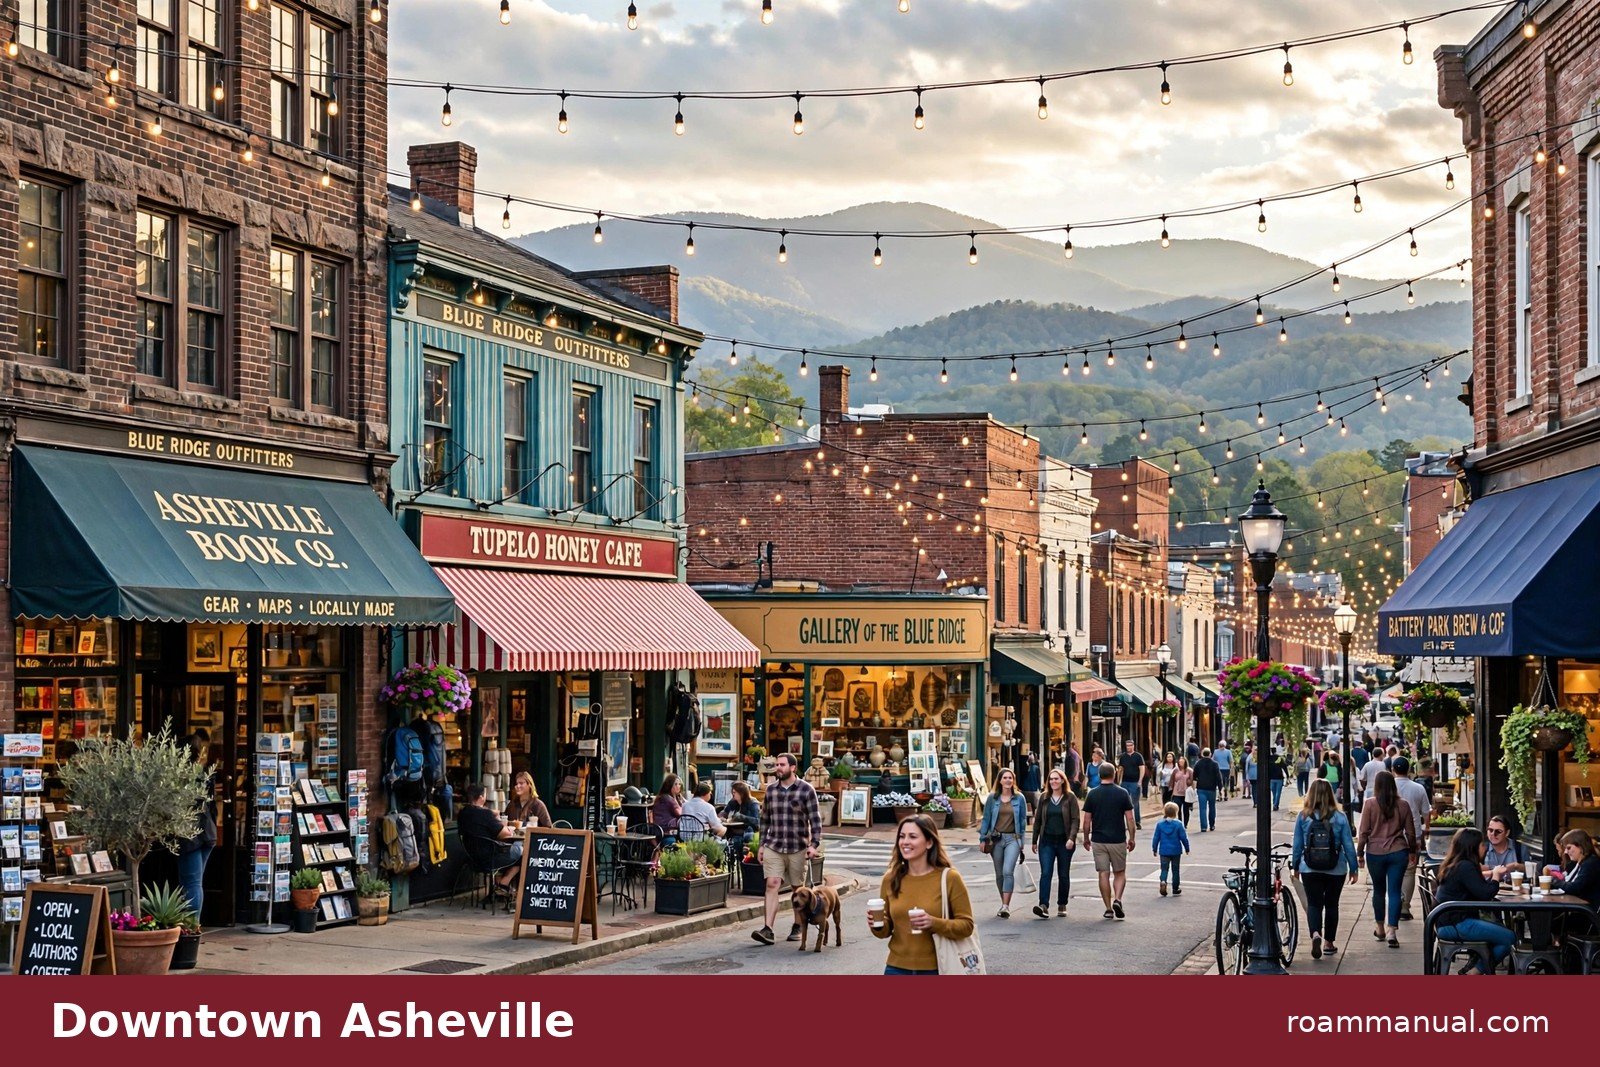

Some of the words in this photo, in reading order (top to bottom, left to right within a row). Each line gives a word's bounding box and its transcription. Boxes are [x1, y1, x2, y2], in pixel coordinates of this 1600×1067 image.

[443, 304, 485, 332] BLUE
[554, 336, 631, 369] OUTFITTERS
[128, 431, 164, 452] BLUE
[170, 436, 212, 458] RIDGE
[216, 443, 294, 469] OUTFITTERS
[153, 490, 335, 536] ASHEVILLE
[186, 530, 297, 566] BOOK
[470, 526, 540, 560] TUPELO
[545, 533, 601, 564] HONEY
[605, 539, 643, 568] CAFE
[203, 596, 240, 613] GEAR
[258, 598, 292, 615] MAPS
[309, 599, 360, 616] LOCALLY
[364, 601, 395, 617] MADE
[799, 617, 861, 645] GALLERY
[863, 622, 878, 642] OF
[880, 623, 899, 642] THE
[904, 618, 934, 644] BLUE
[938, 617, 966, 645] RIDGE
[1388, 616, 1425, 637] BATTERY
[1427, 615, 1450, 637] PARK
[1453, 613, 1479, 636] BREW
[1481, 615, 1487, 635] &
[530, 883, 550, 895] LOCAL
[552, 886, 575, 896] COFFEE
[43, 902, 72, 917] OPEN
[529, 897, 553, 908] SWEET
[555, 899, 568, 910] TEA
[40, 923, 74, 940] LOCAL
[29, 942, 78, 961] AUTHORS
